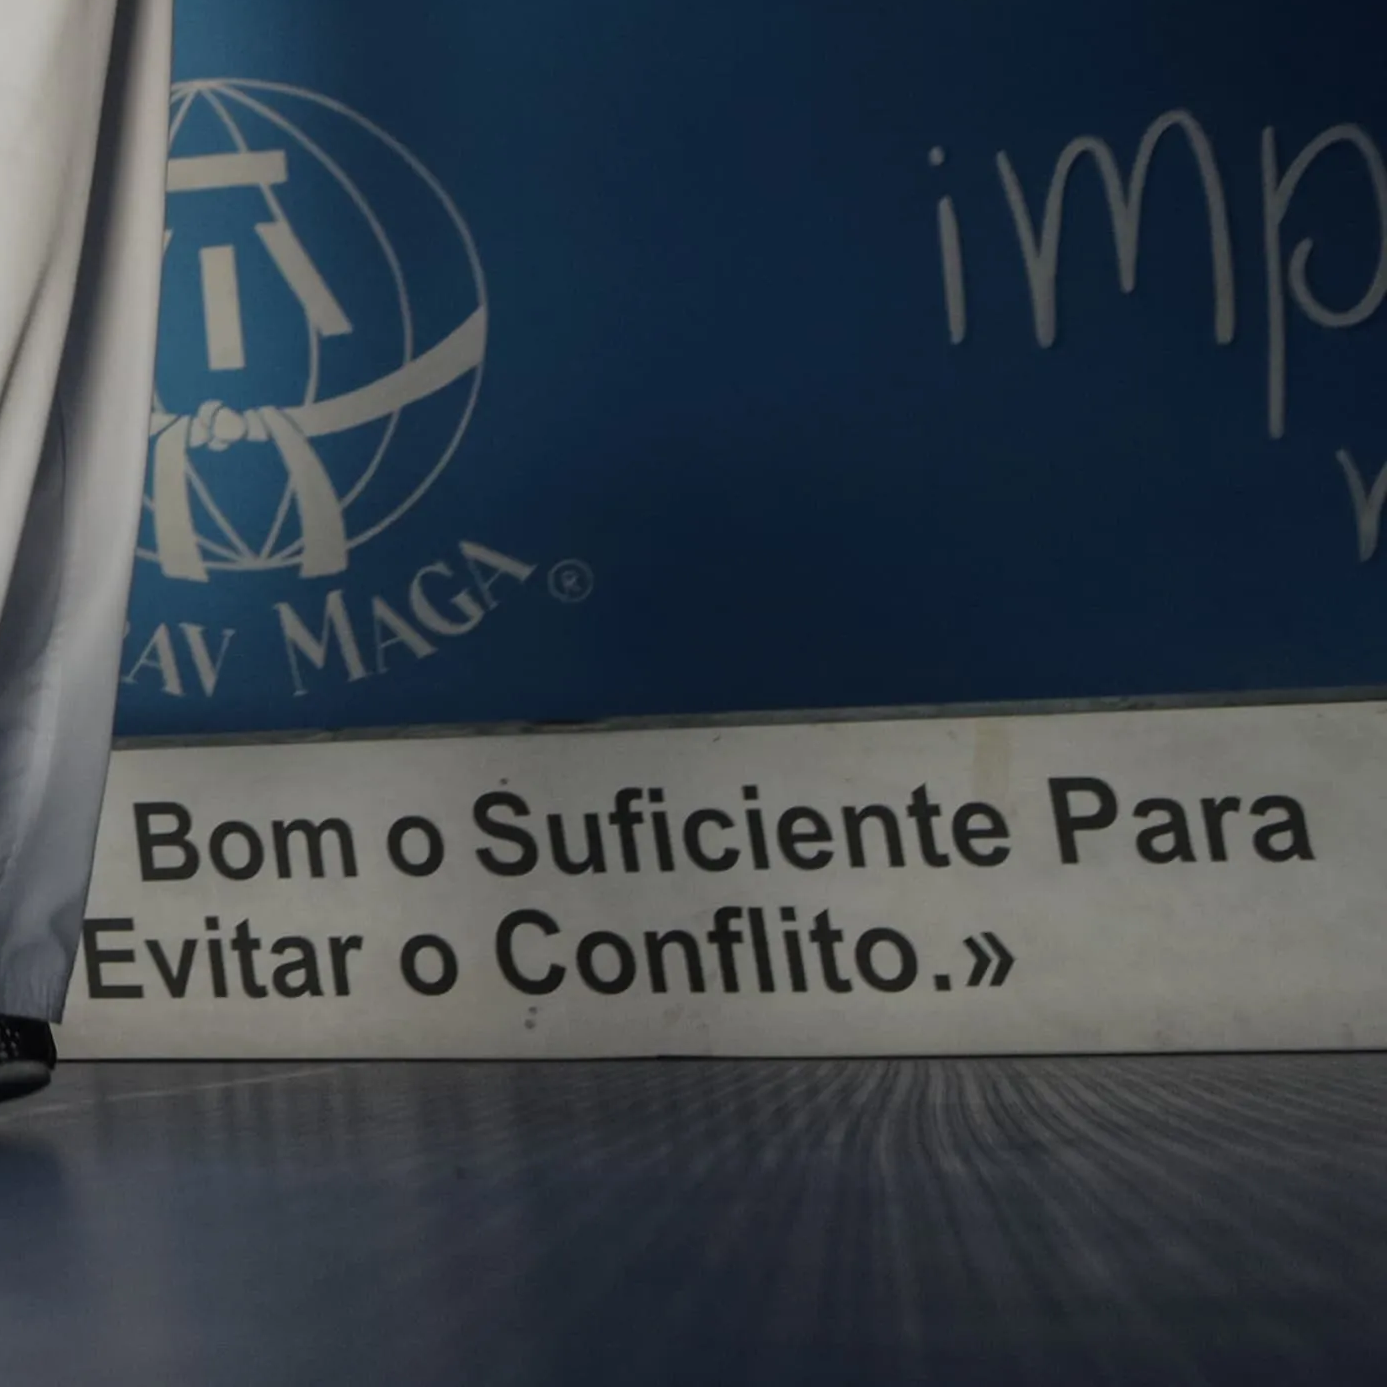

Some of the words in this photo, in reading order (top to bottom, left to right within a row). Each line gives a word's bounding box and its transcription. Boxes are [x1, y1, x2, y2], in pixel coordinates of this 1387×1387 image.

[120, 621, 236, 698] AV
[273, 540, 539, 697] MAGA
[132, 800, 359, 883] Bom
[386, 815, 445, 877] o
[471, 781, 1012, 877] Suficiente
[1046, 775, 1316, 866] Para
[81, 915, 364, 1000] Evitar
[398, 933, 459, 997] o
[494, 904, 1015, 996] Conflito.»
